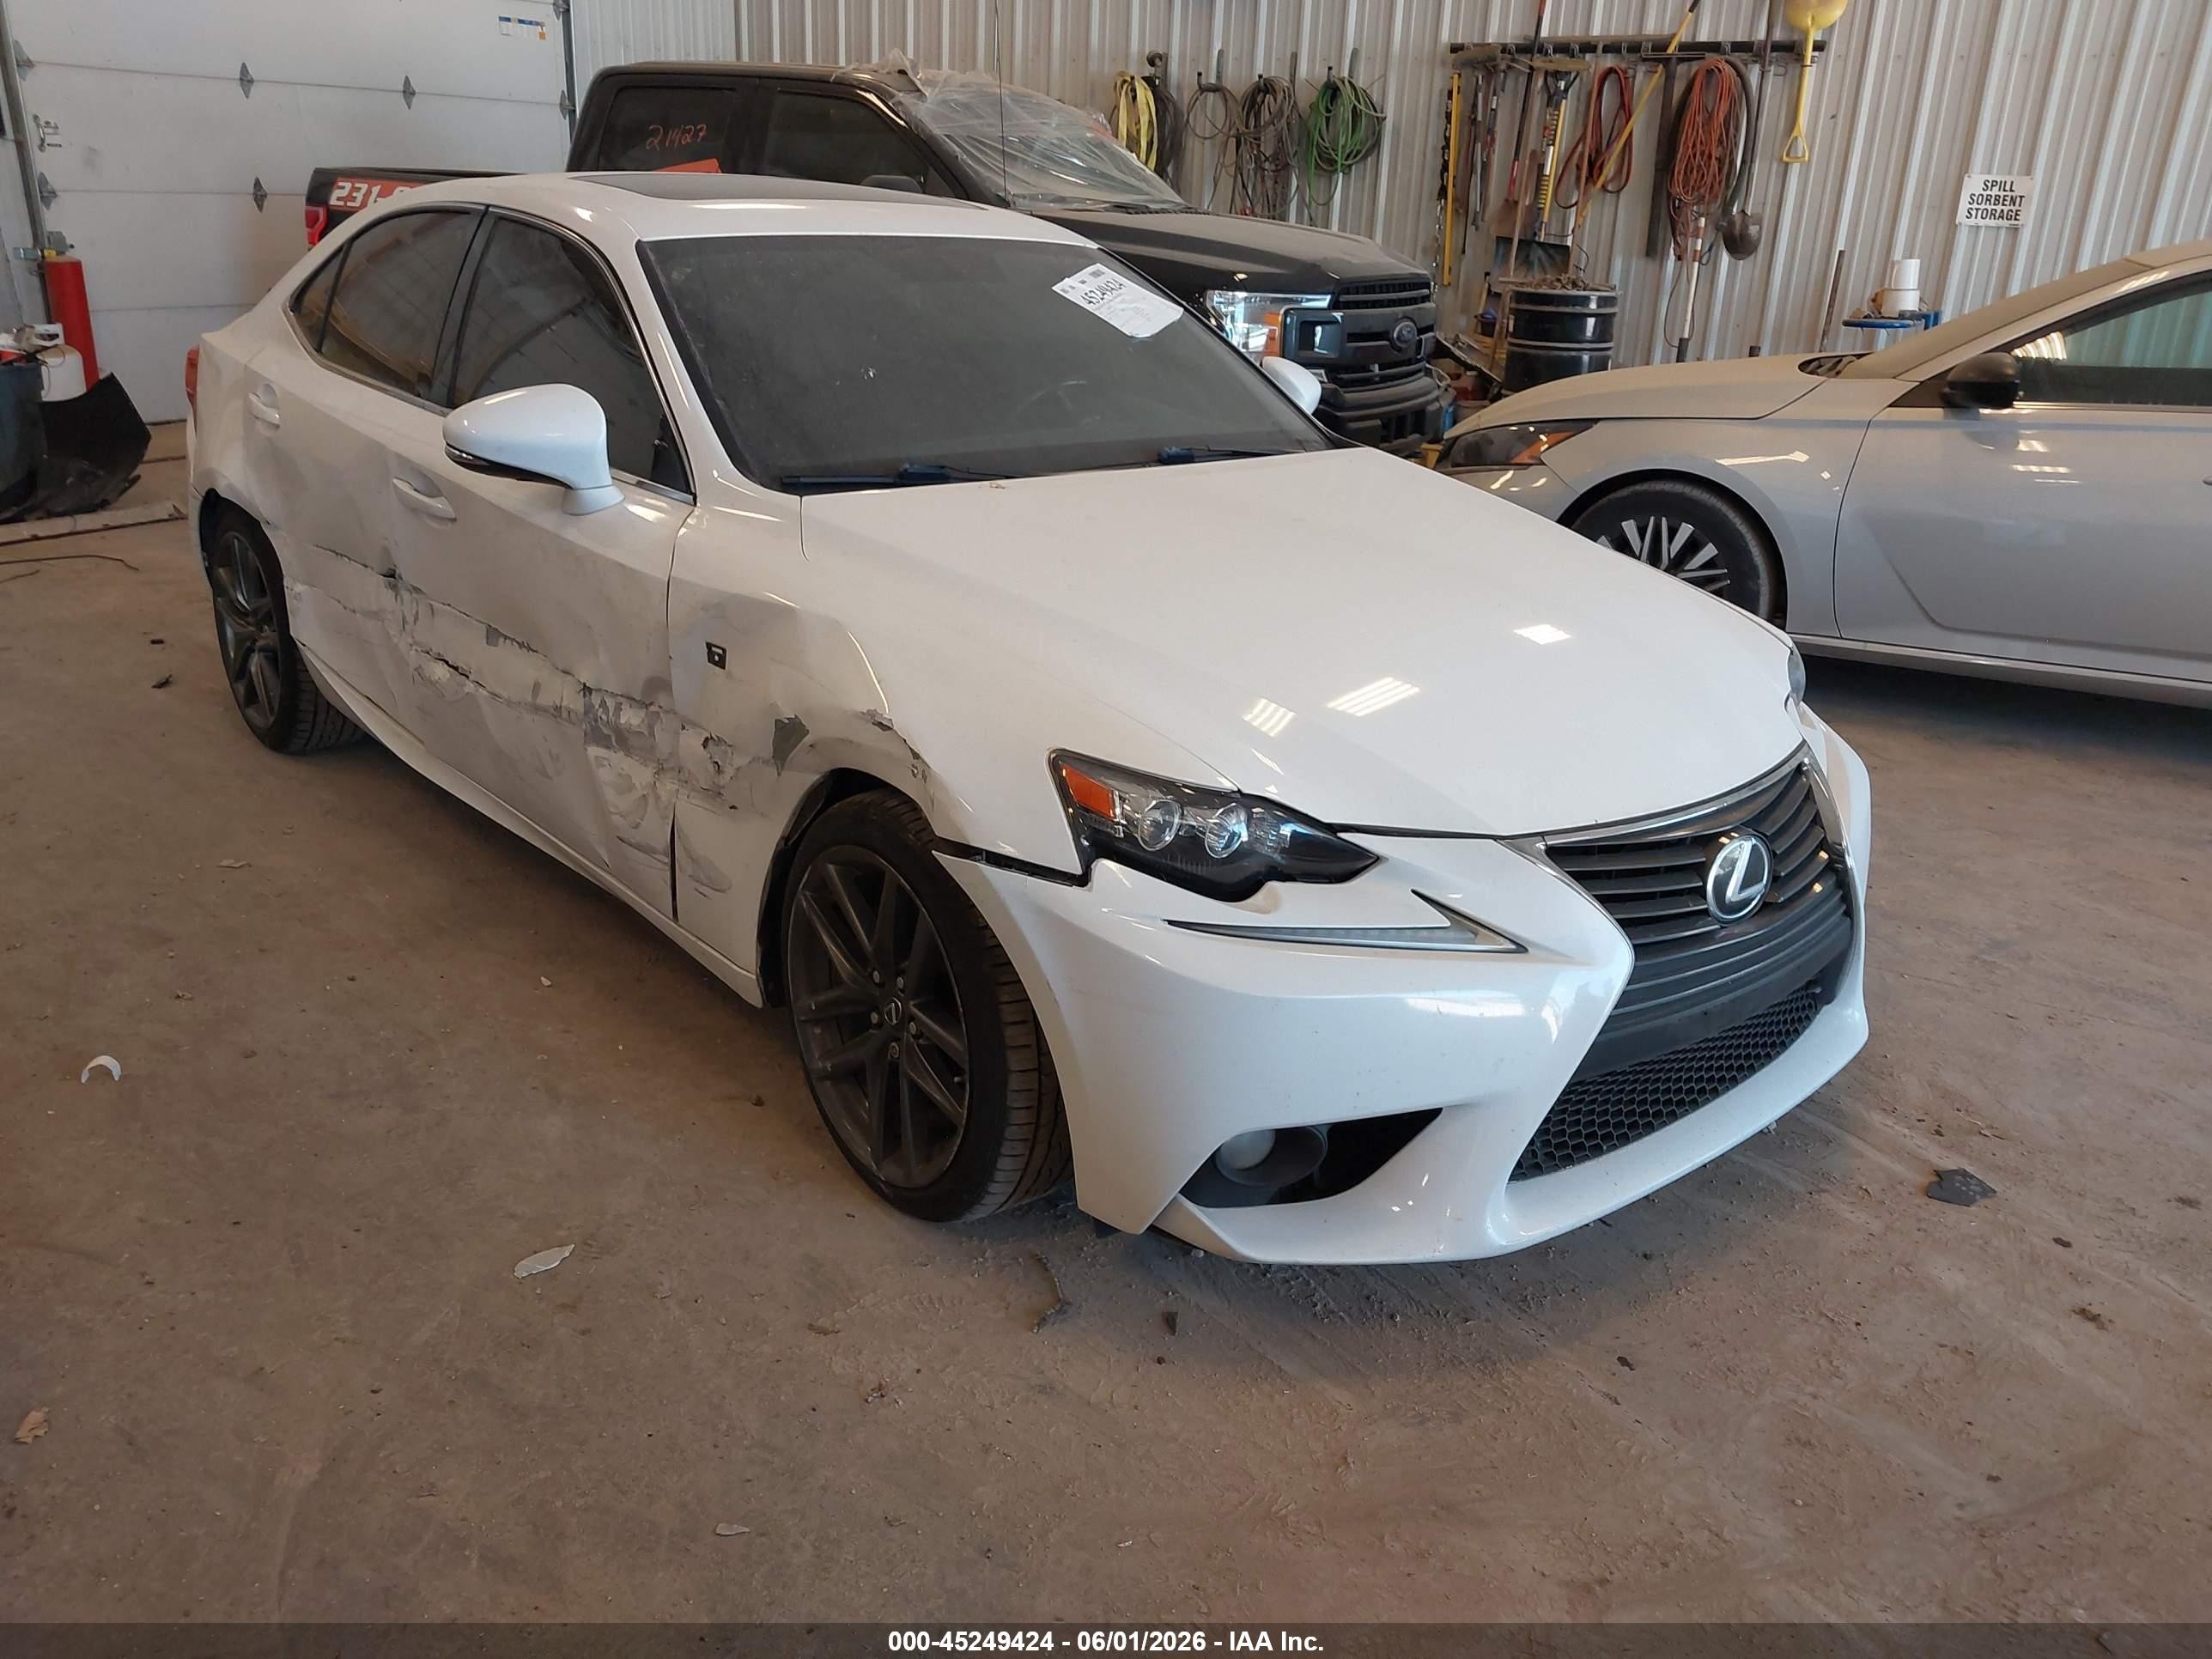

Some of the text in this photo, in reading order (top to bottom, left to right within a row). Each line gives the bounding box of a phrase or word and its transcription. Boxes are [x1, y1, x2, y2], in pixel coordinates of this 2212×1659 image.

[1982, 179, 2015, 192] SPILL
[1967, 192, 2026, 208] SORBENT
[1965, 207, 2021, 221] STORAGE
